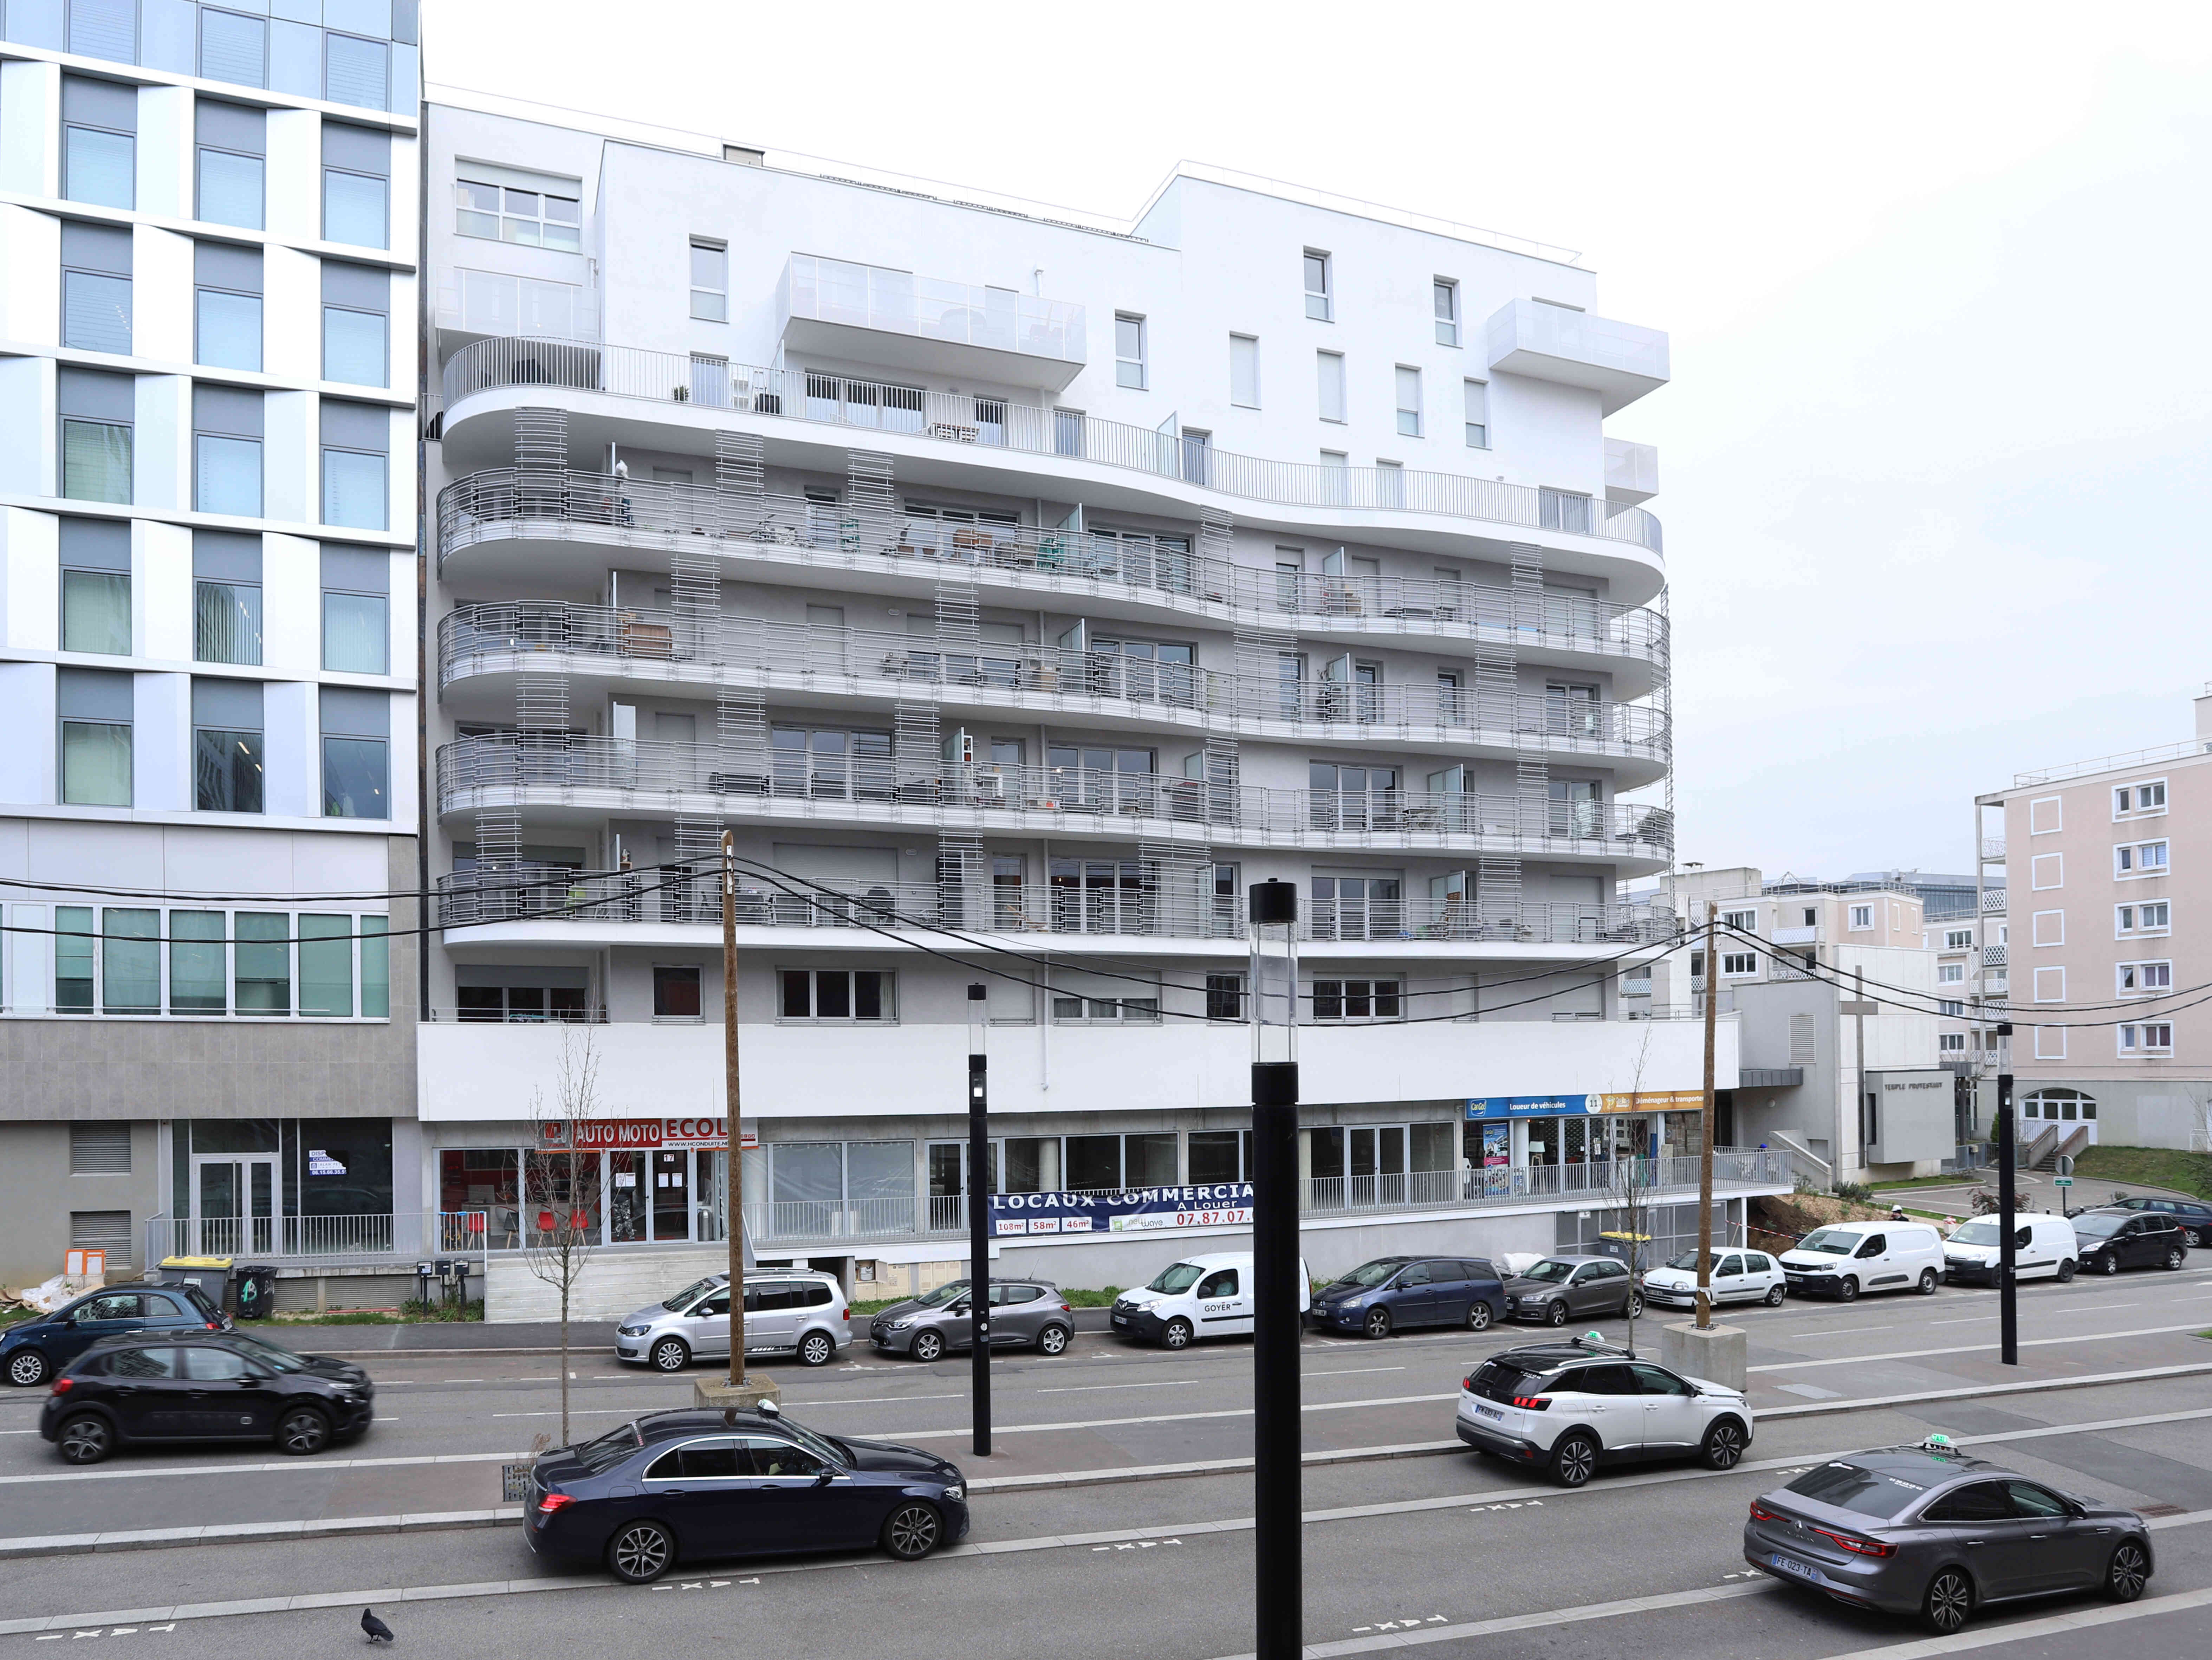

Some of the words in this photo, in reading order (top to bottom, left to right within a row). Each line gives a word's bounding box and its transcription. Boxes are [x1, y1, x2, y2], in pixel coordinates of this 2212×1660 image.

[577, 1124, 614, 1142] AUTO
[619, 1124, 660, 1142] MOTO
[667, 1118, 727, 1137] ECOL
[993, 1193, 1096, 1209] LOCAUX
[1107, 1184, 1253, 1206] COMMERCIA
[1177, 1202, 1187, 1211] A
[1194, 1200, 1237, 1210] Louer
[1177, 1210, 1253, 1226] 07.87.07.
[1932, 1434, 1947, 1442] TAXI
[1777, 1557, 1811, 1576] FE-023-TA
[652, 1577, 760, 1590] TAXI
[35, 1623, 175, 1640] TAXI
